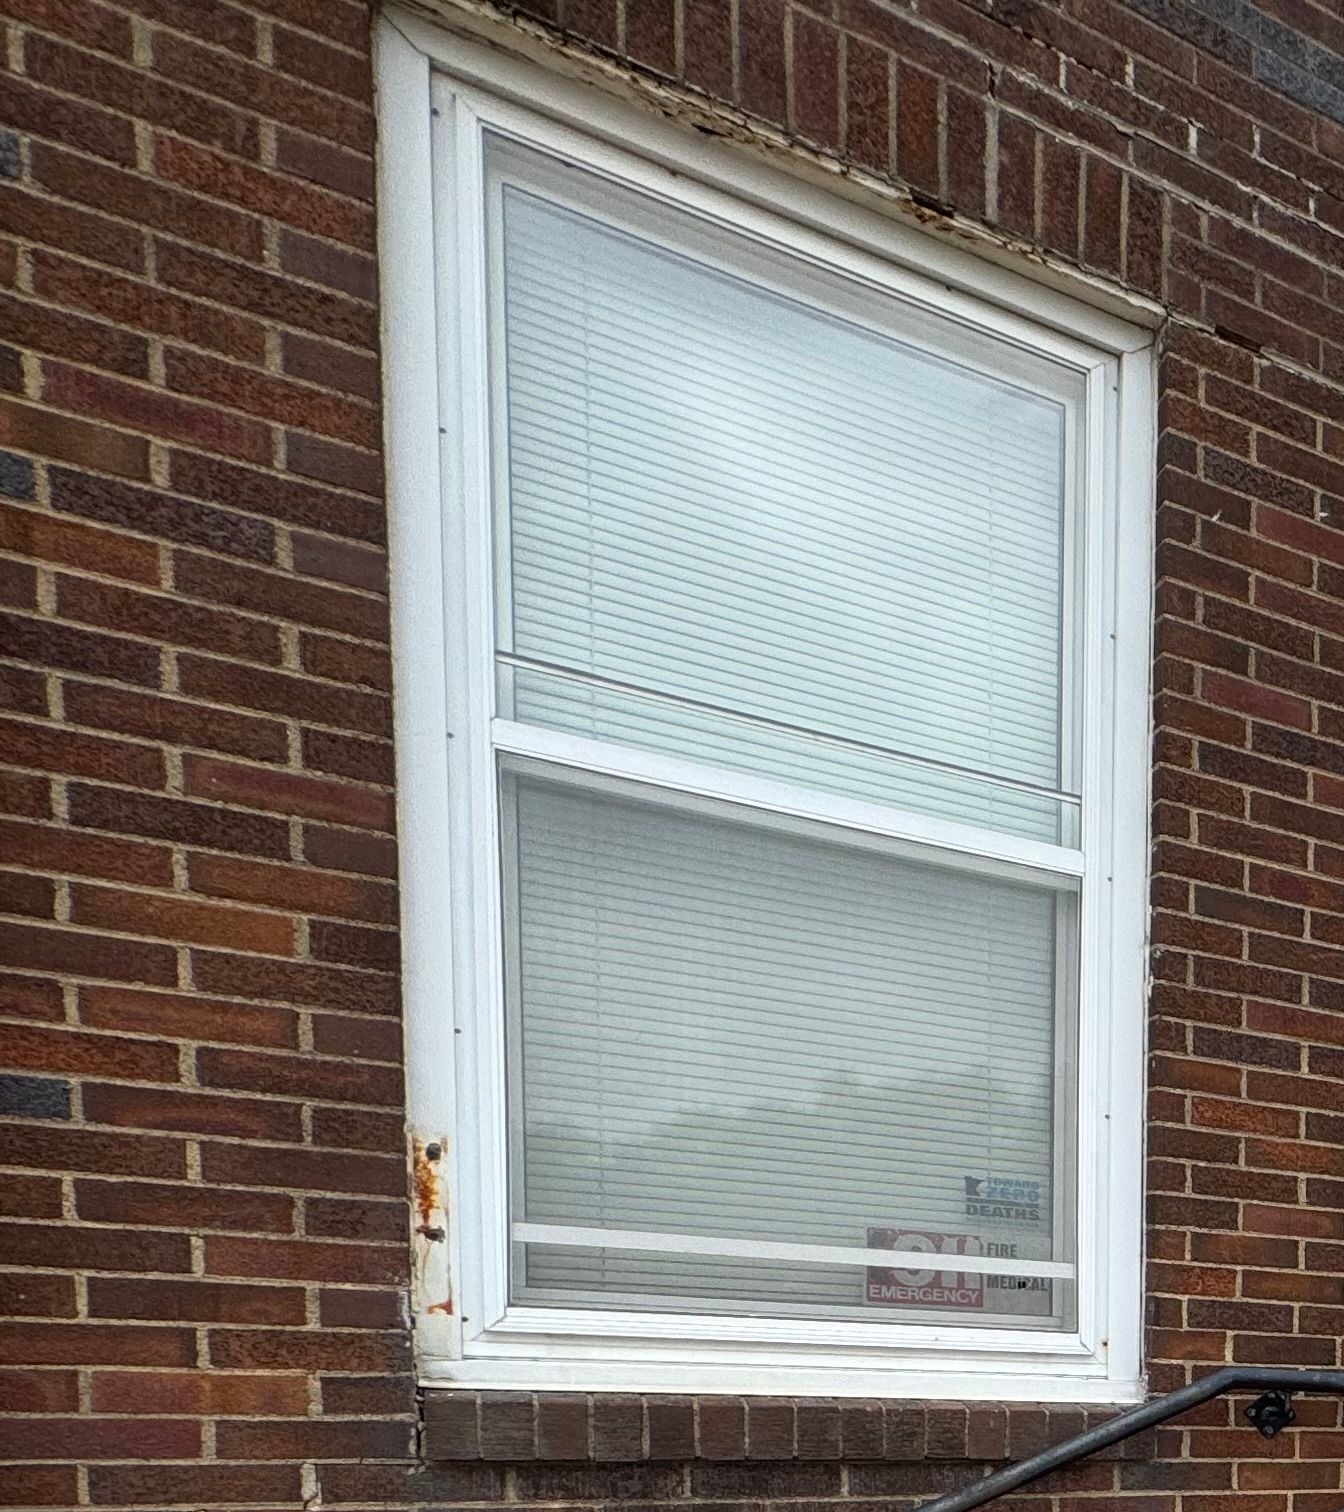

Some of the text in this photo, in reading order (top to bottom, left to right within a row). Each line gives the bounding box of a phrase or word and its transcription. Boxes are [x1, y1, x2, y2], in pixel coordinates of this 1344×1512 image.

[965, 1203, 1041, 1221] DEATHS
[986, 1241, 1018, 1259] FIRE
[868, 1284, 980, 1304] EMERGENCY
